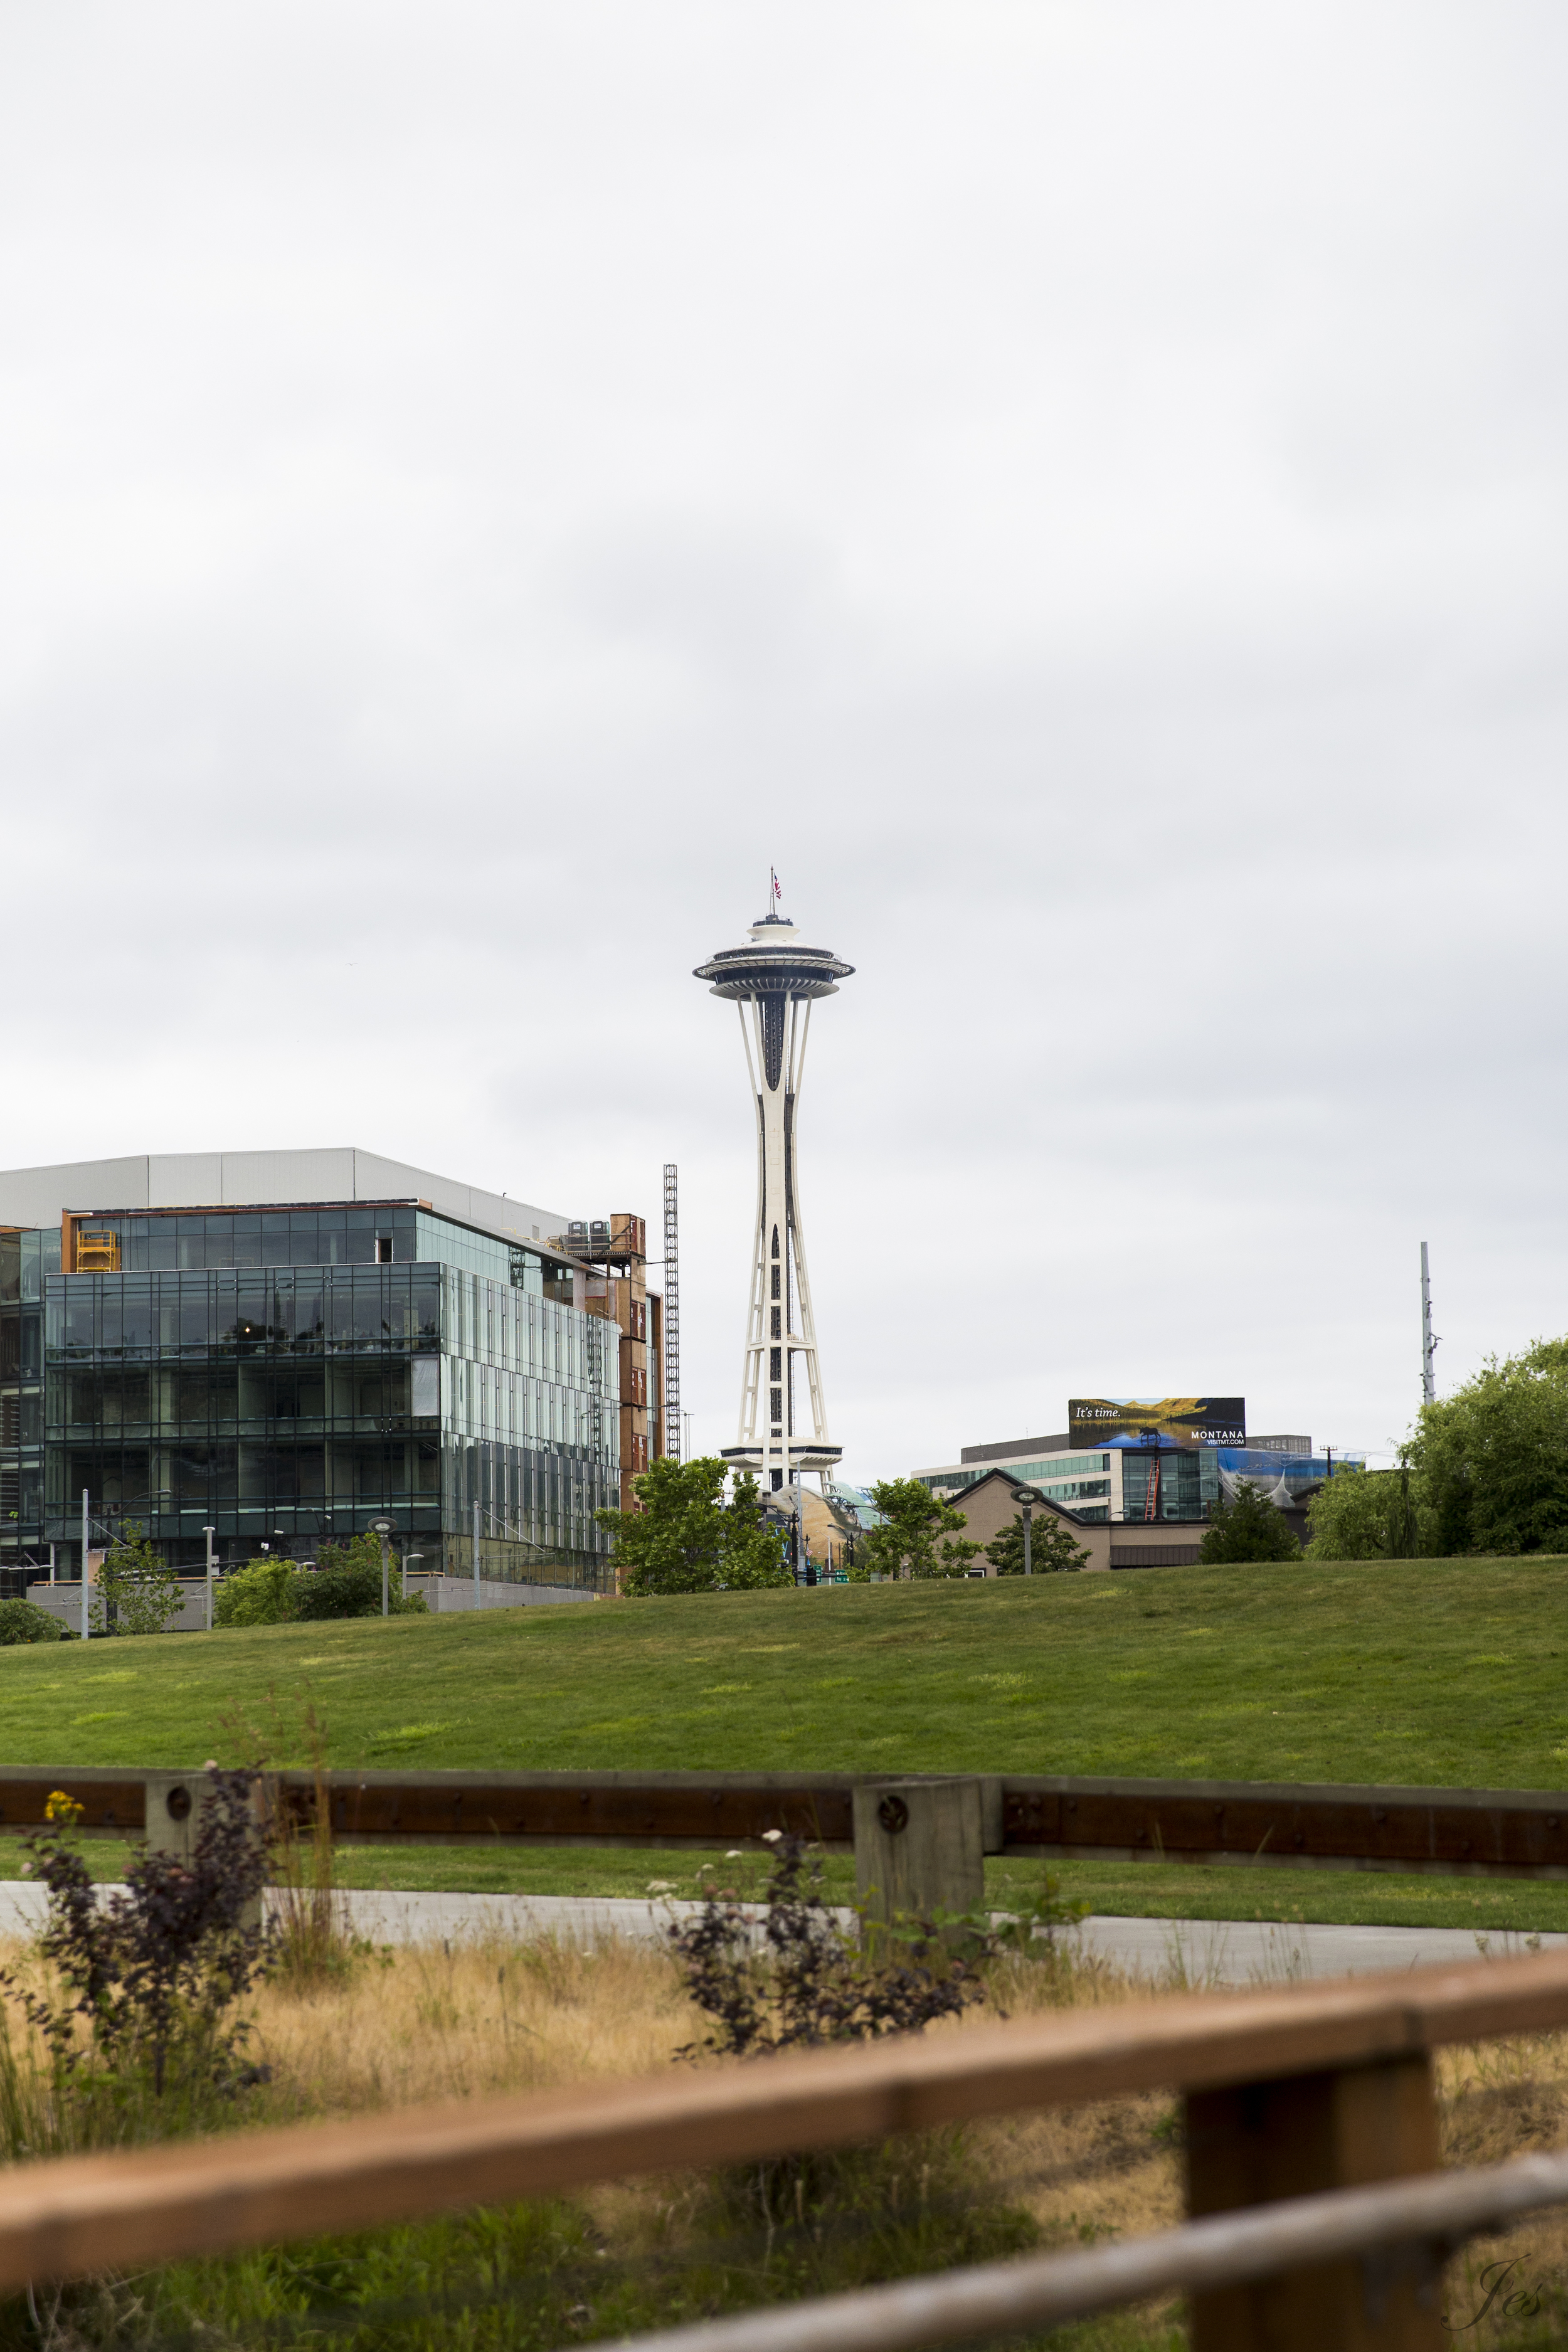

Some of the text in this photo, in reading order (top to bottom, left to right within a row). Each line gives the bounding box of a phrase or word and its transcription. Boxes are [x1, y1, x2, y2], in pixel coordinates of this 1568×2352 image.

[1076, 1407, 1121, 1417] It's time.
[1191, 1431, 1243, 1439] MONTANA
